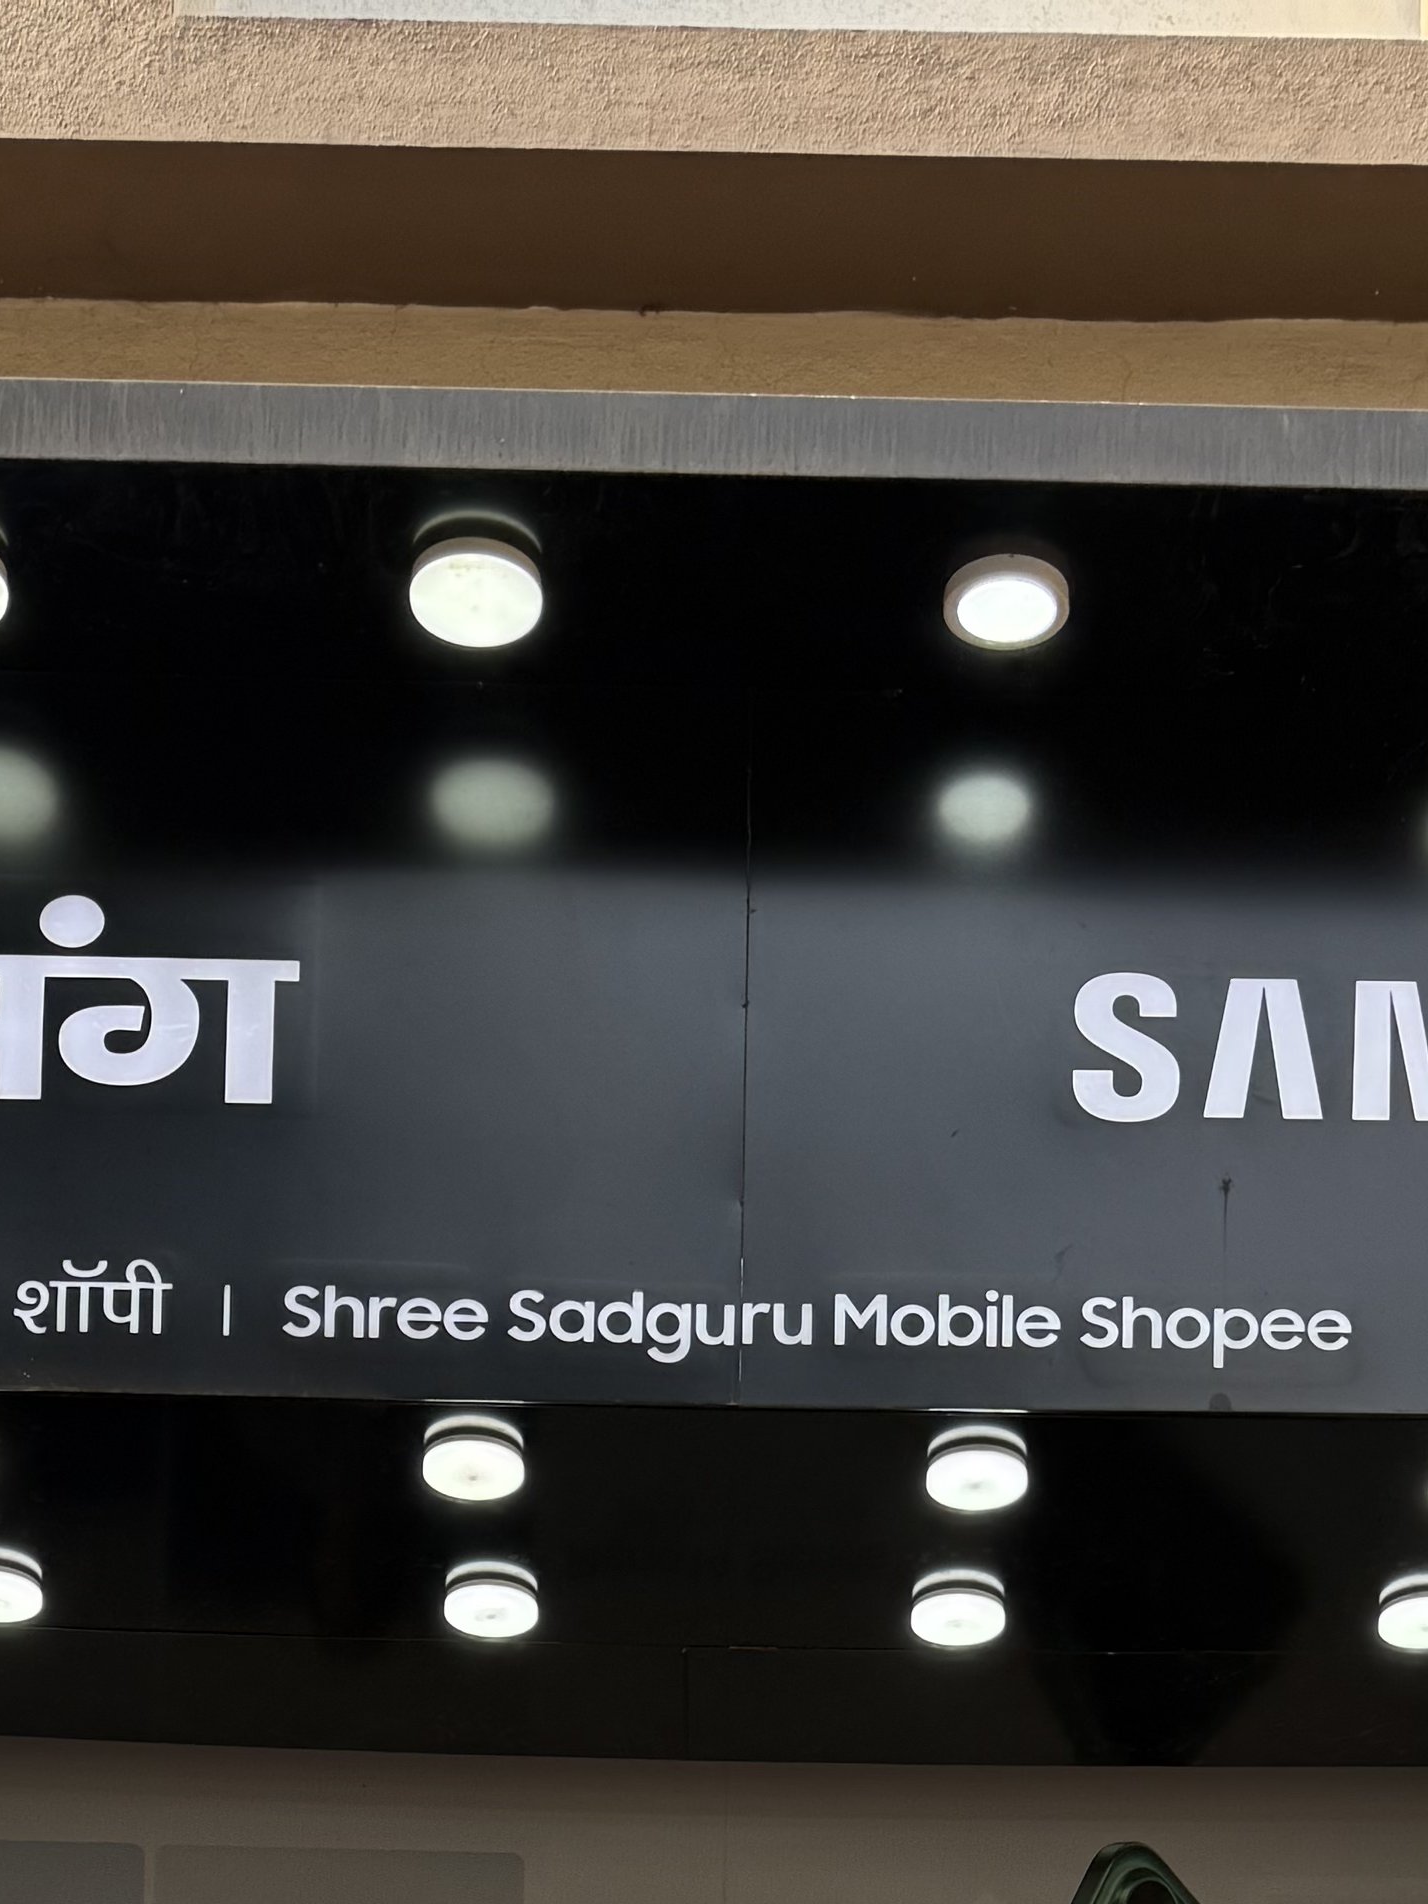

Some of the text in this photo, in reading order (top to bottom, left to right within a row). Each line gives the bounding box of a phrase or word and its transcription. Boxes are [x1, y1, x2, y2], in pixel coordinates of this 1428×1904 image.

[12, 1259, 172, 1335] शॉपी
[282, 1285, 1353, 1368] Shree Sadguru Mobile Shopee
